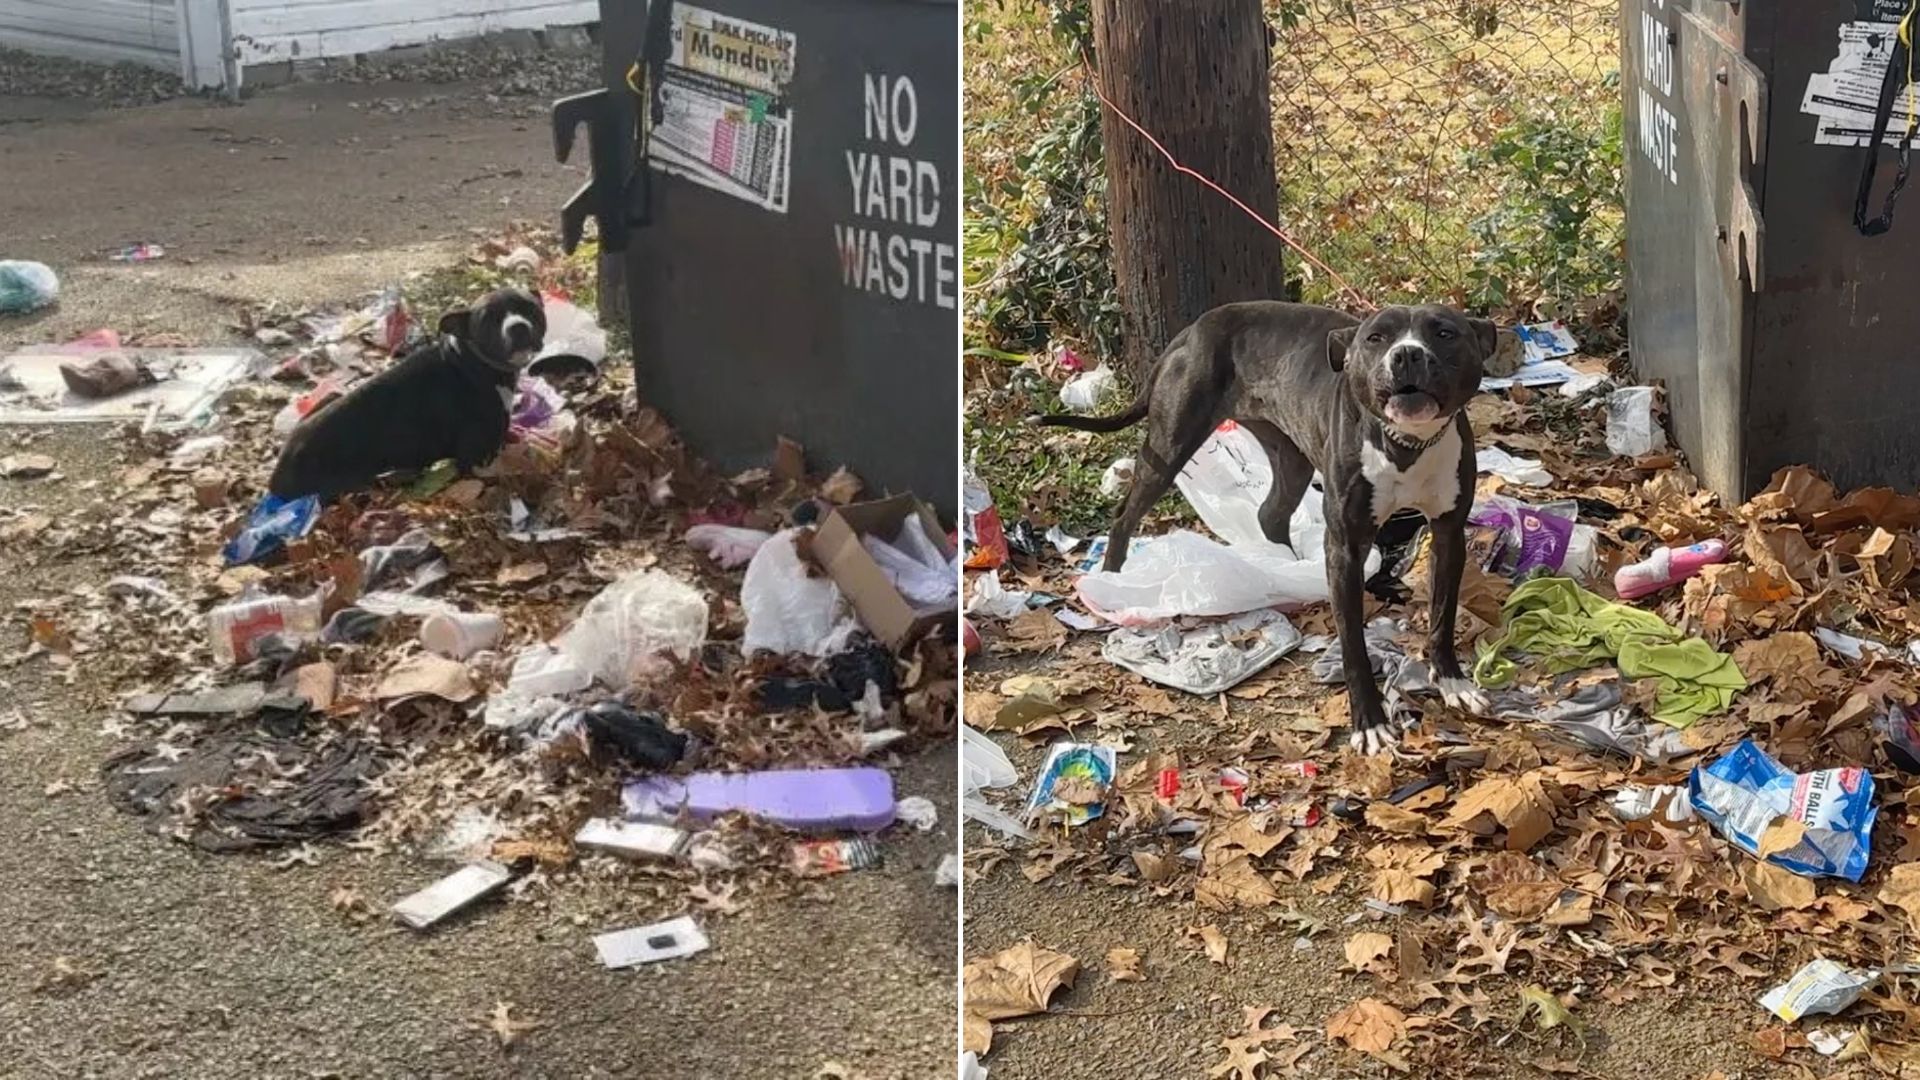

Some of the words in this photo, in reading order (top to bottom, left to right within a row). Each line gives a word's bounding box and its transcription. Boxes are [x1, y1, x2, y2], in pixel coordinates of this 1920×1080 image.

[1642, 10, 1673, 97] YARD
[864, 73, 918, 147] NO
[1638, 87, 1678, 186] WASTE
[845, 149, 941, 228] YARD
[834, 223, 956, 310] WASTE
